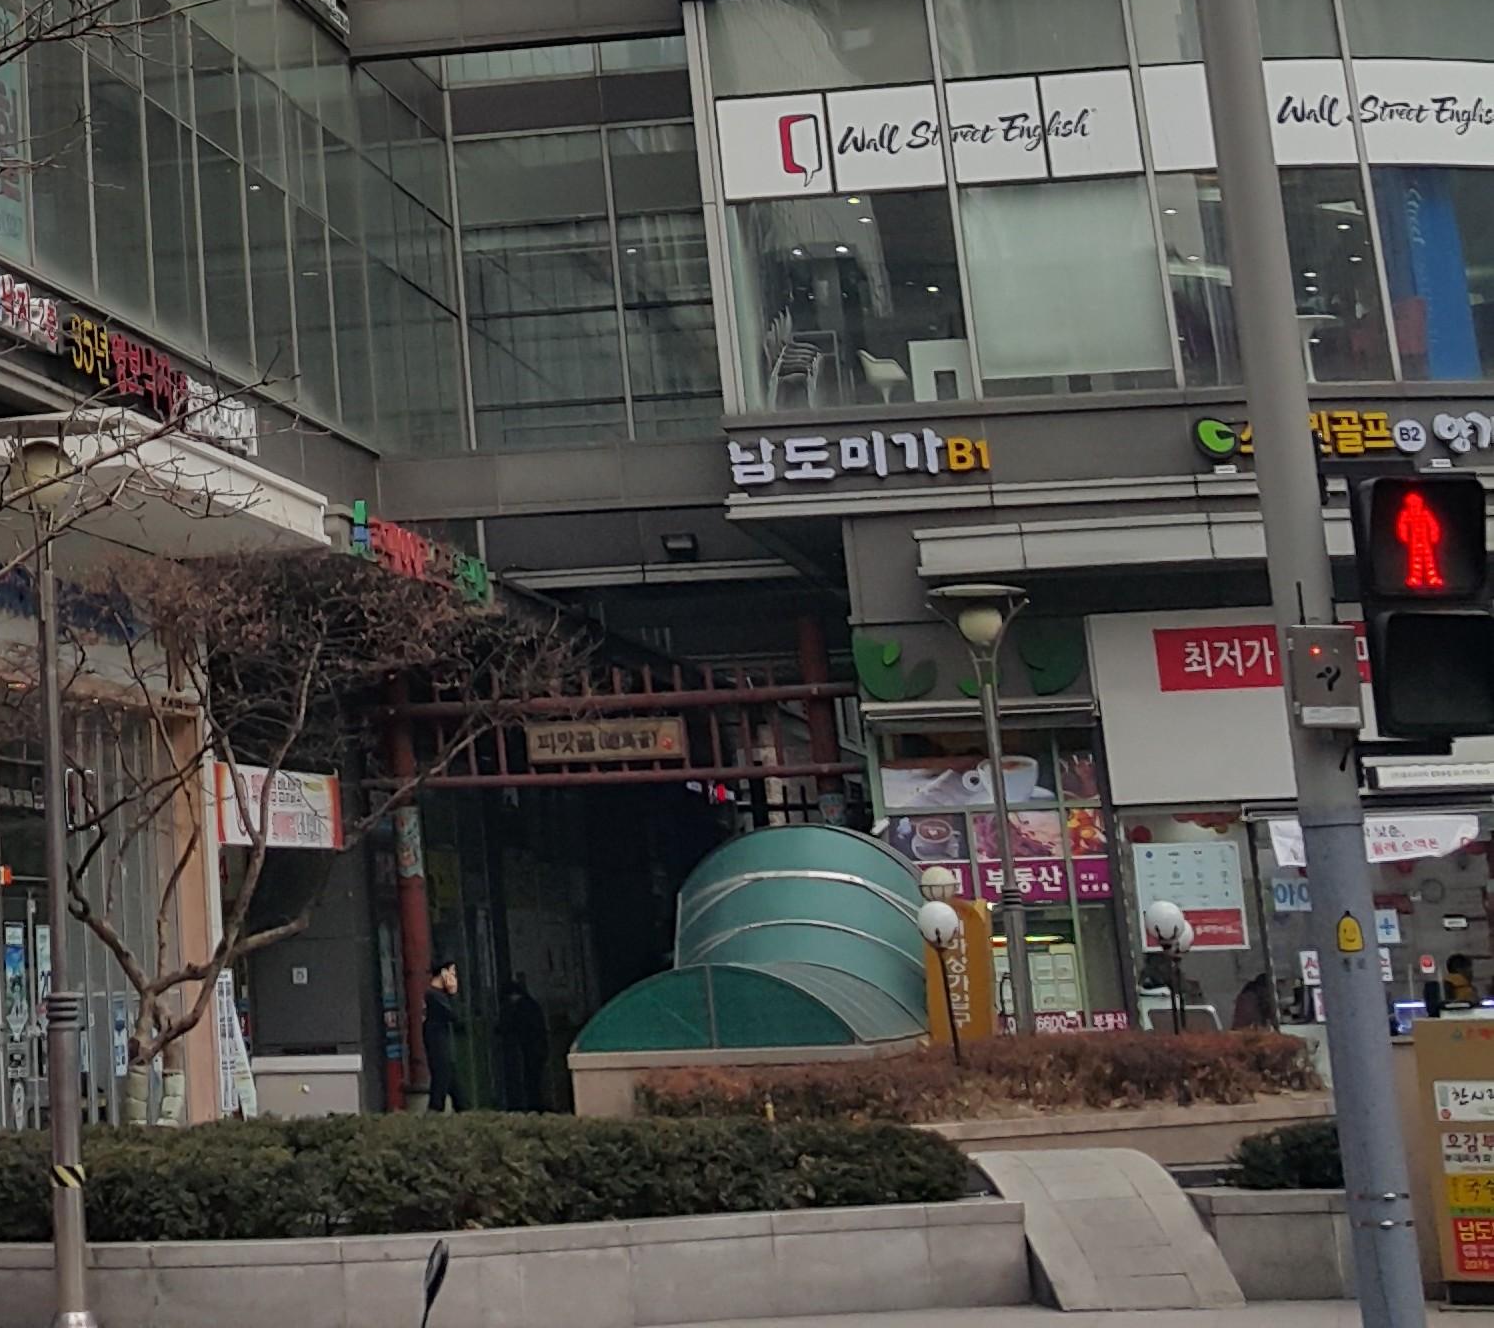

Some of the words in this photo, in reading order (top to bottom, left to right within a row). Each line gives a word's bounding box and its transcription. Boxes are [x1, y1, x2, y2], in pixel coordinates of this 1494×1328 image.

[838, 125, 902, 156] Wall
[905, 120, 996, 150] Street
[999, 108, 1091, 153] English
[1276, 94, 1343, 126] Wall
[1345, 94, 1432, 124] Street
[1431, 94, 1494, 135] Englis
[1398, 425, 1422, 442] B2
[727, 428, 946, 486] 남도미가
[946, 436, 992, 473] B1
[1183, 637, 1276, 678] 최저가
[985, 864, 1063, 895] 부동산
